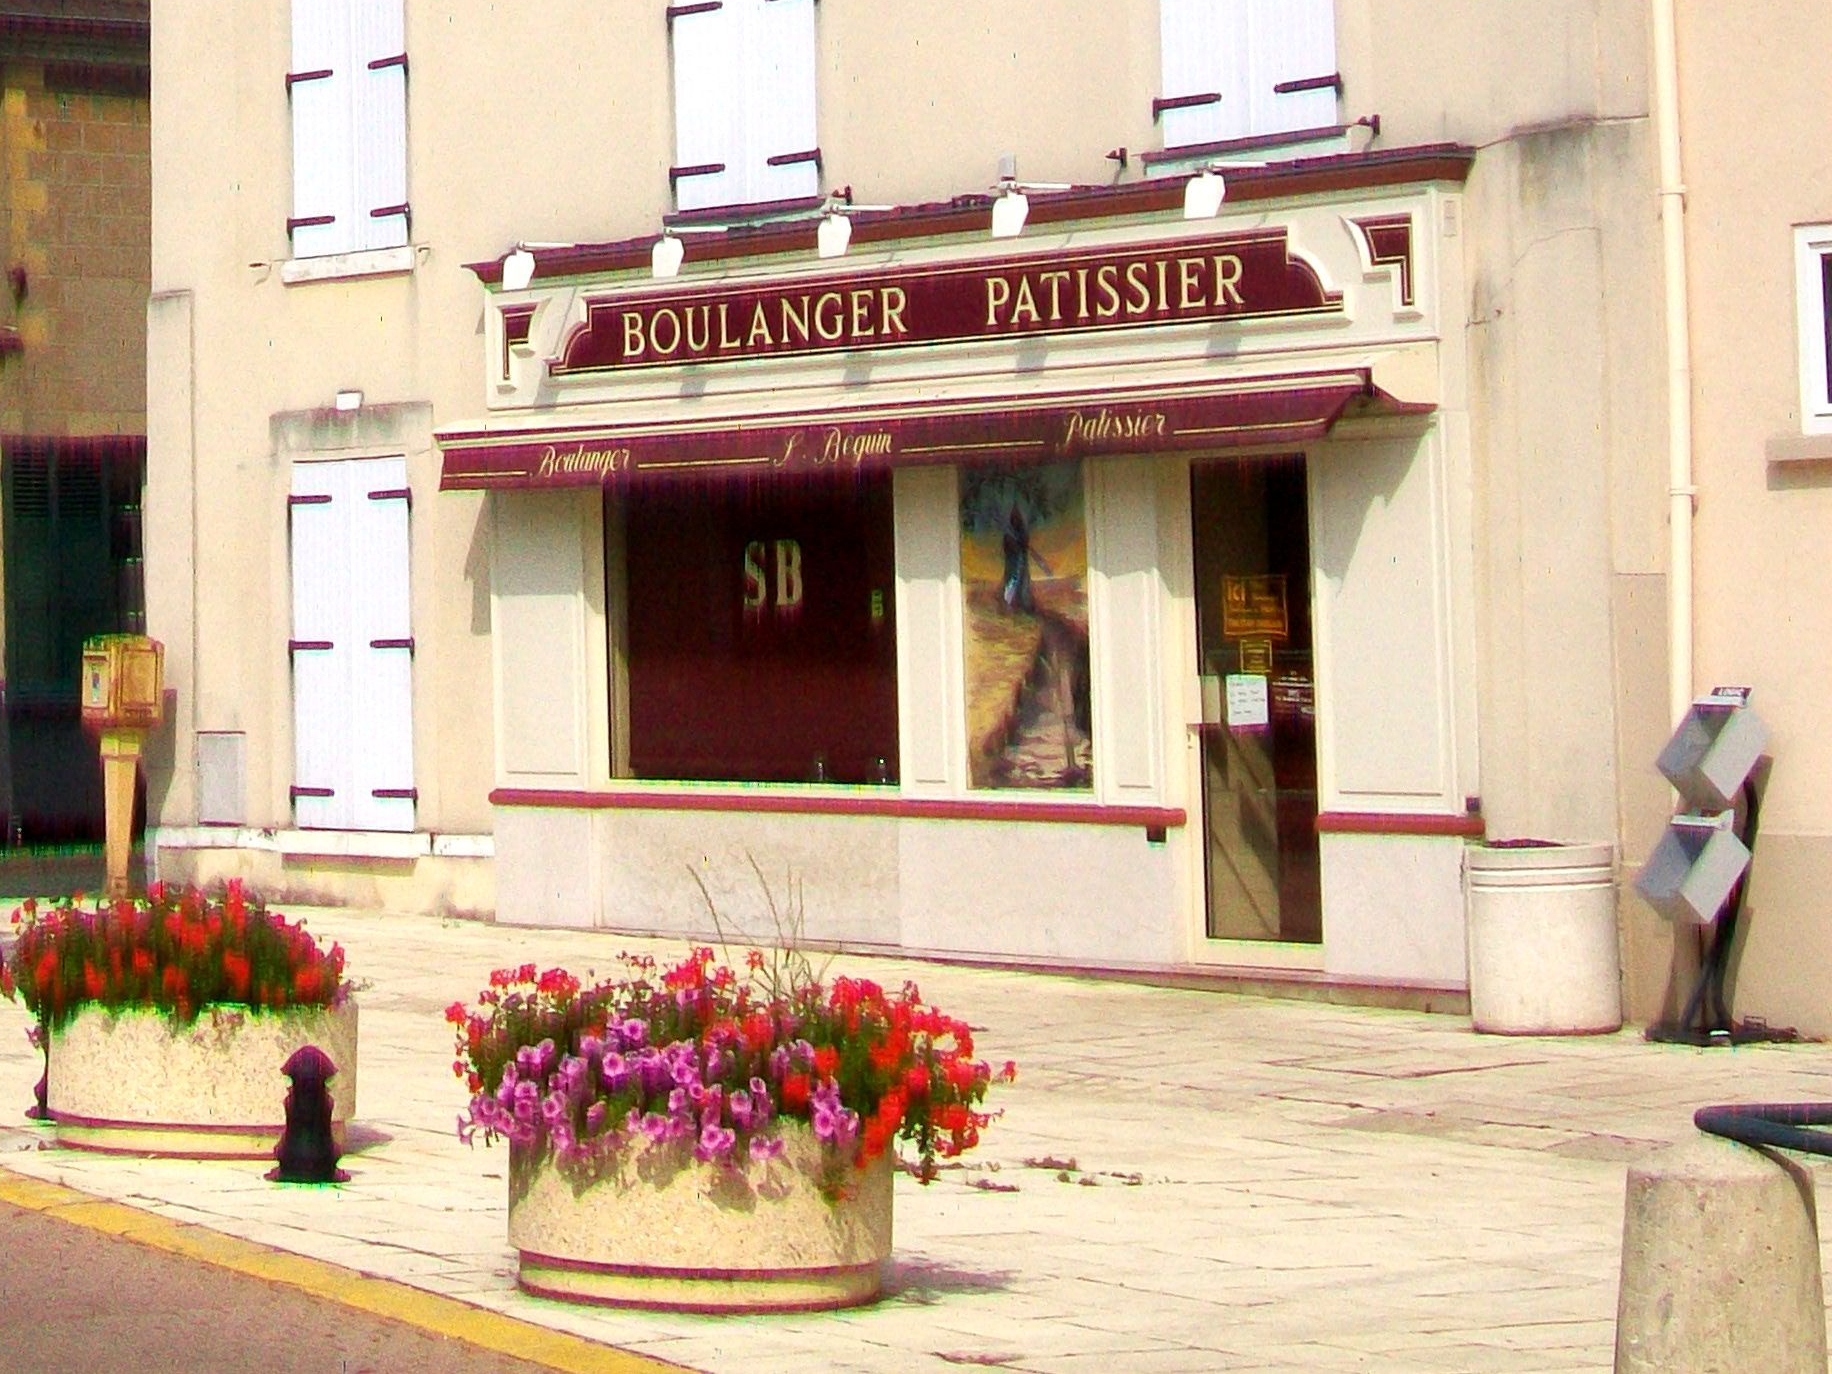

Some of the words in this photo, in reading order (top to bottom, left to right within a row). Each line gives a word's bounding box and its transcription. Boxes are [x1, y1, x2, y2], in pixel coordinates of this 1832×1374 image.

[622, 287, 908, 356] BOULANGER
[985, 254, 1244, 327] PATISSIER
[538, 444, 630, 480] Boulanger
